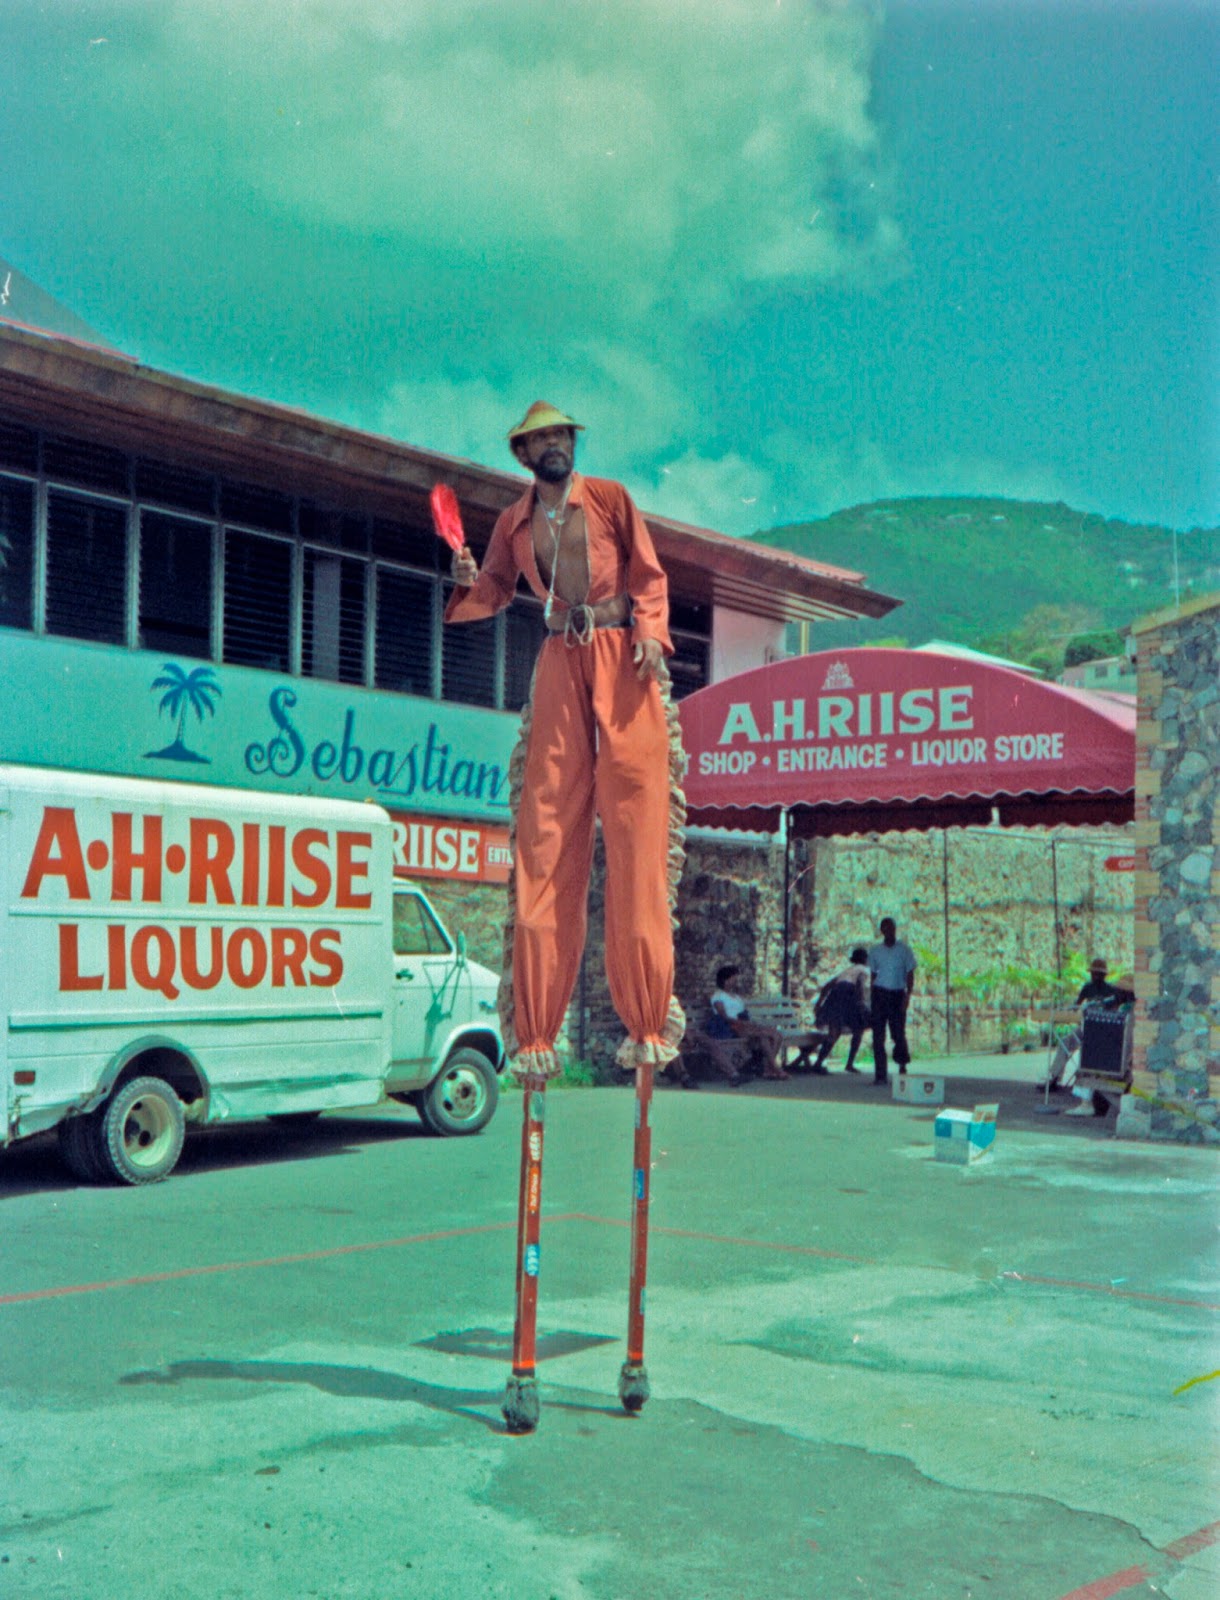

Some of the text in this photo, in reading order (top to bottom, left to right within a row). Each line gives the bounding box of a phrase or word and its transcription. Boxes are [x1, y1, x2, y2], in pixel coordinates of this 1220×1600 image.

[244, 687, 510, 806] Sebastian
[699, 751, 757, 775] SHOP
[777, 743, 888, 772] ENTRANCE
[911, 737, 987, 767] LIQUOR
[994, 732, 1066, 762] STORE
[58, 923, 344, 1000] LIQUORS
